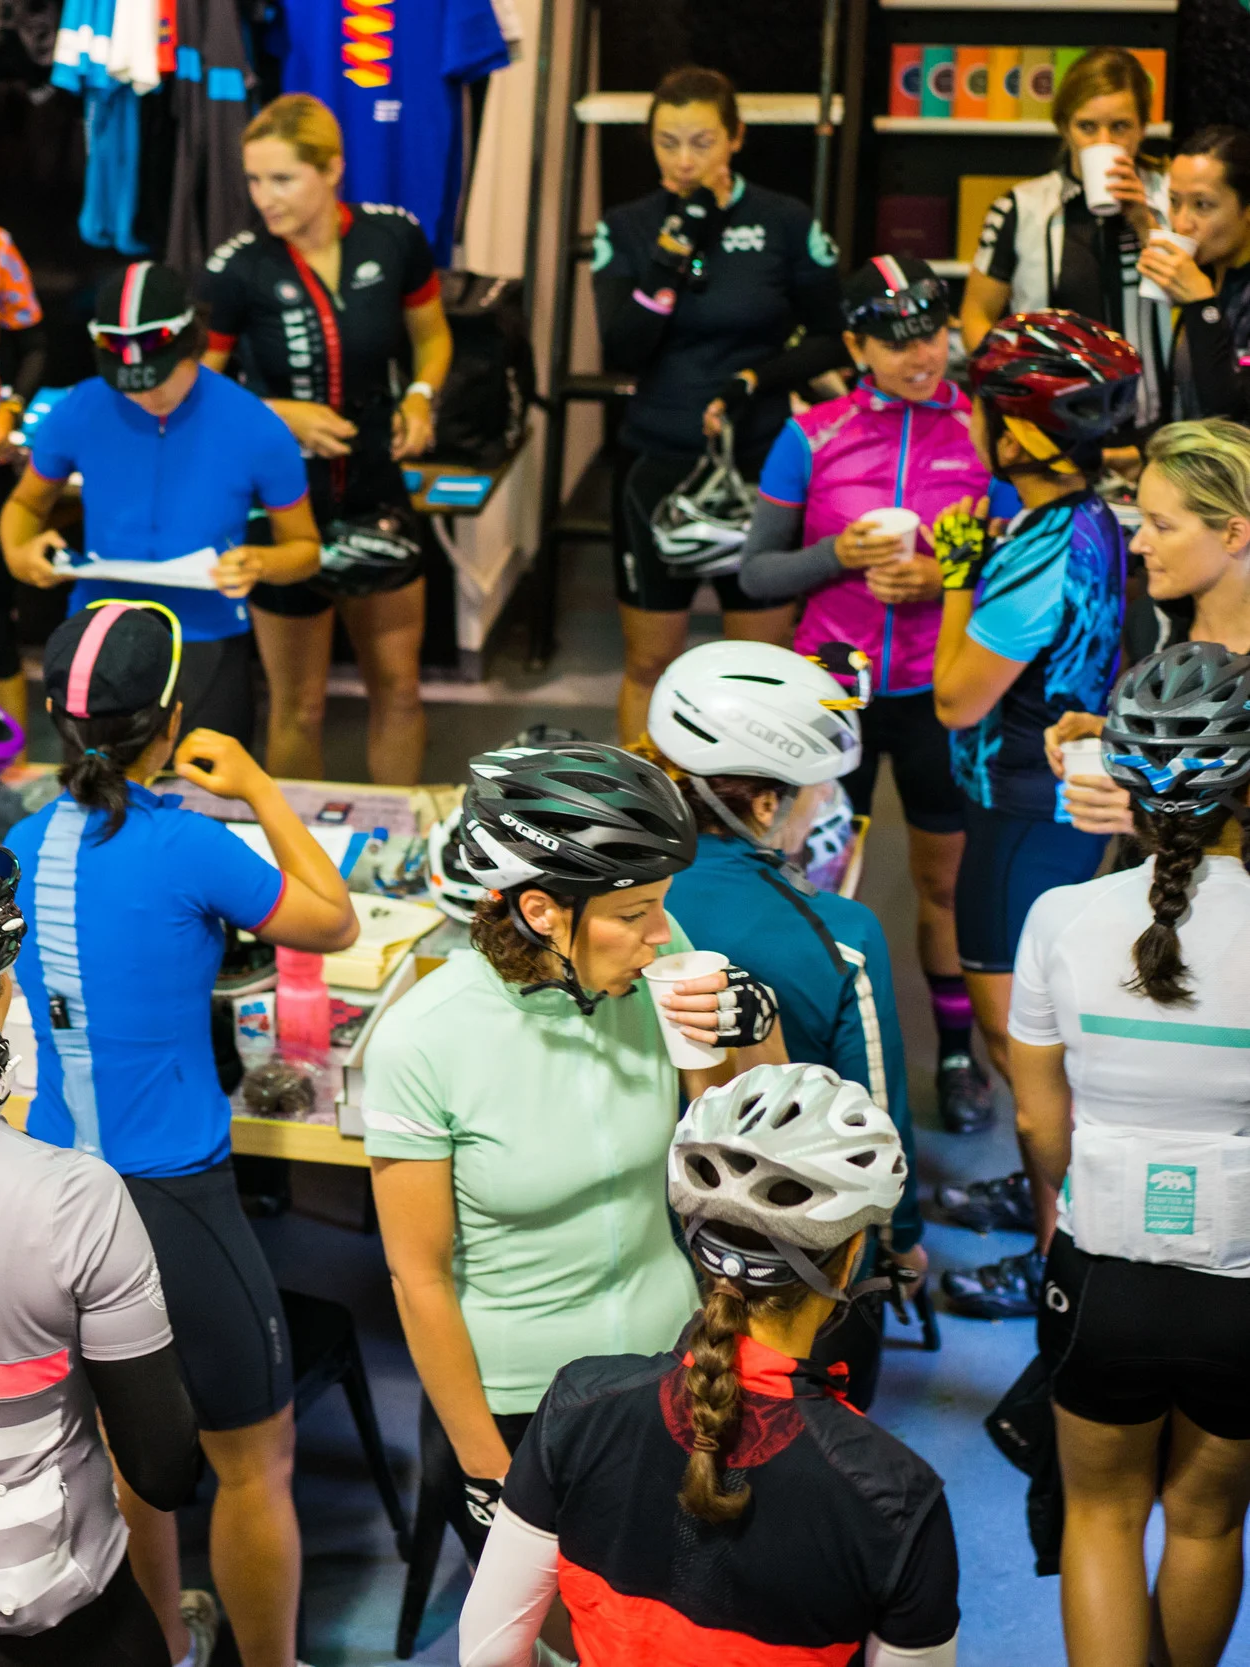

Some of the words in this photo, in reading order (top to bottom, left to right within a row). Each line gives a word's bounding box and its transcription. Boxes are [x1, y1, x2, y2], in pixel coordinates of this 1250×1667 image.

[892, 314, 934, 340] RCC
[117, 366, 157, 389] RCC
[746, 719, 805, 759] GIRO
[513, 821, 560, 851] GIRO
